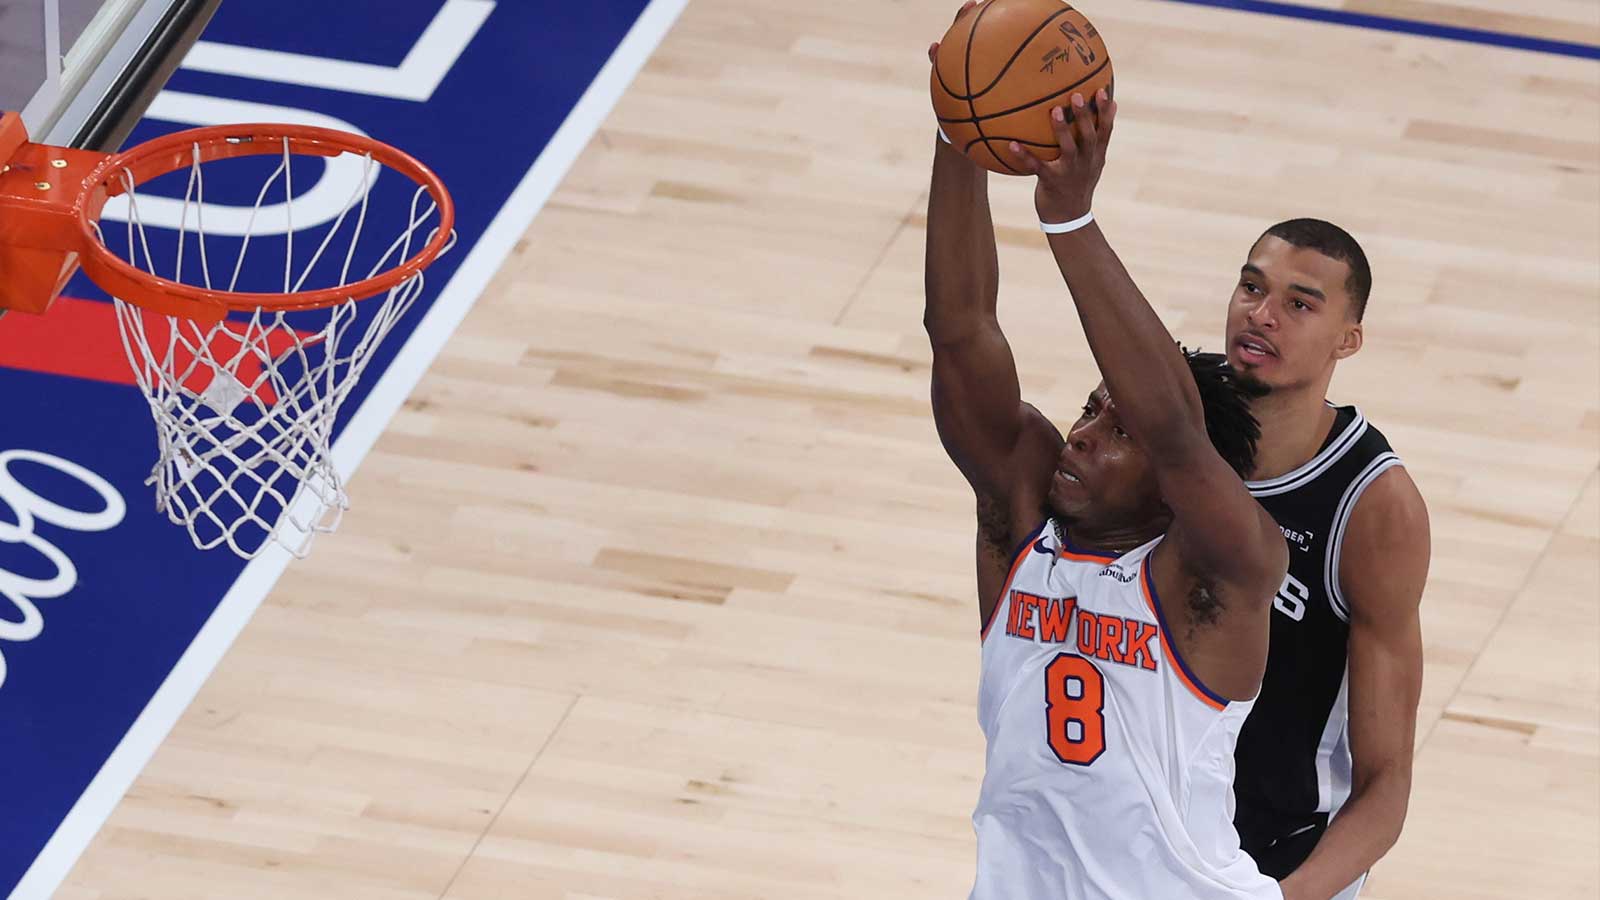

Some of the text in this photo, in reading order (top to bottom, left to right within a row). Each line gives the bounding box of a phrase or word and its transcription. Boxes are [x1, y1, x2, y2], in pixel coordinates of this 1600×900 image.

[1006, 590, 1159, 672] NEW ORK
[1044, 652, 1106, 767] 8
